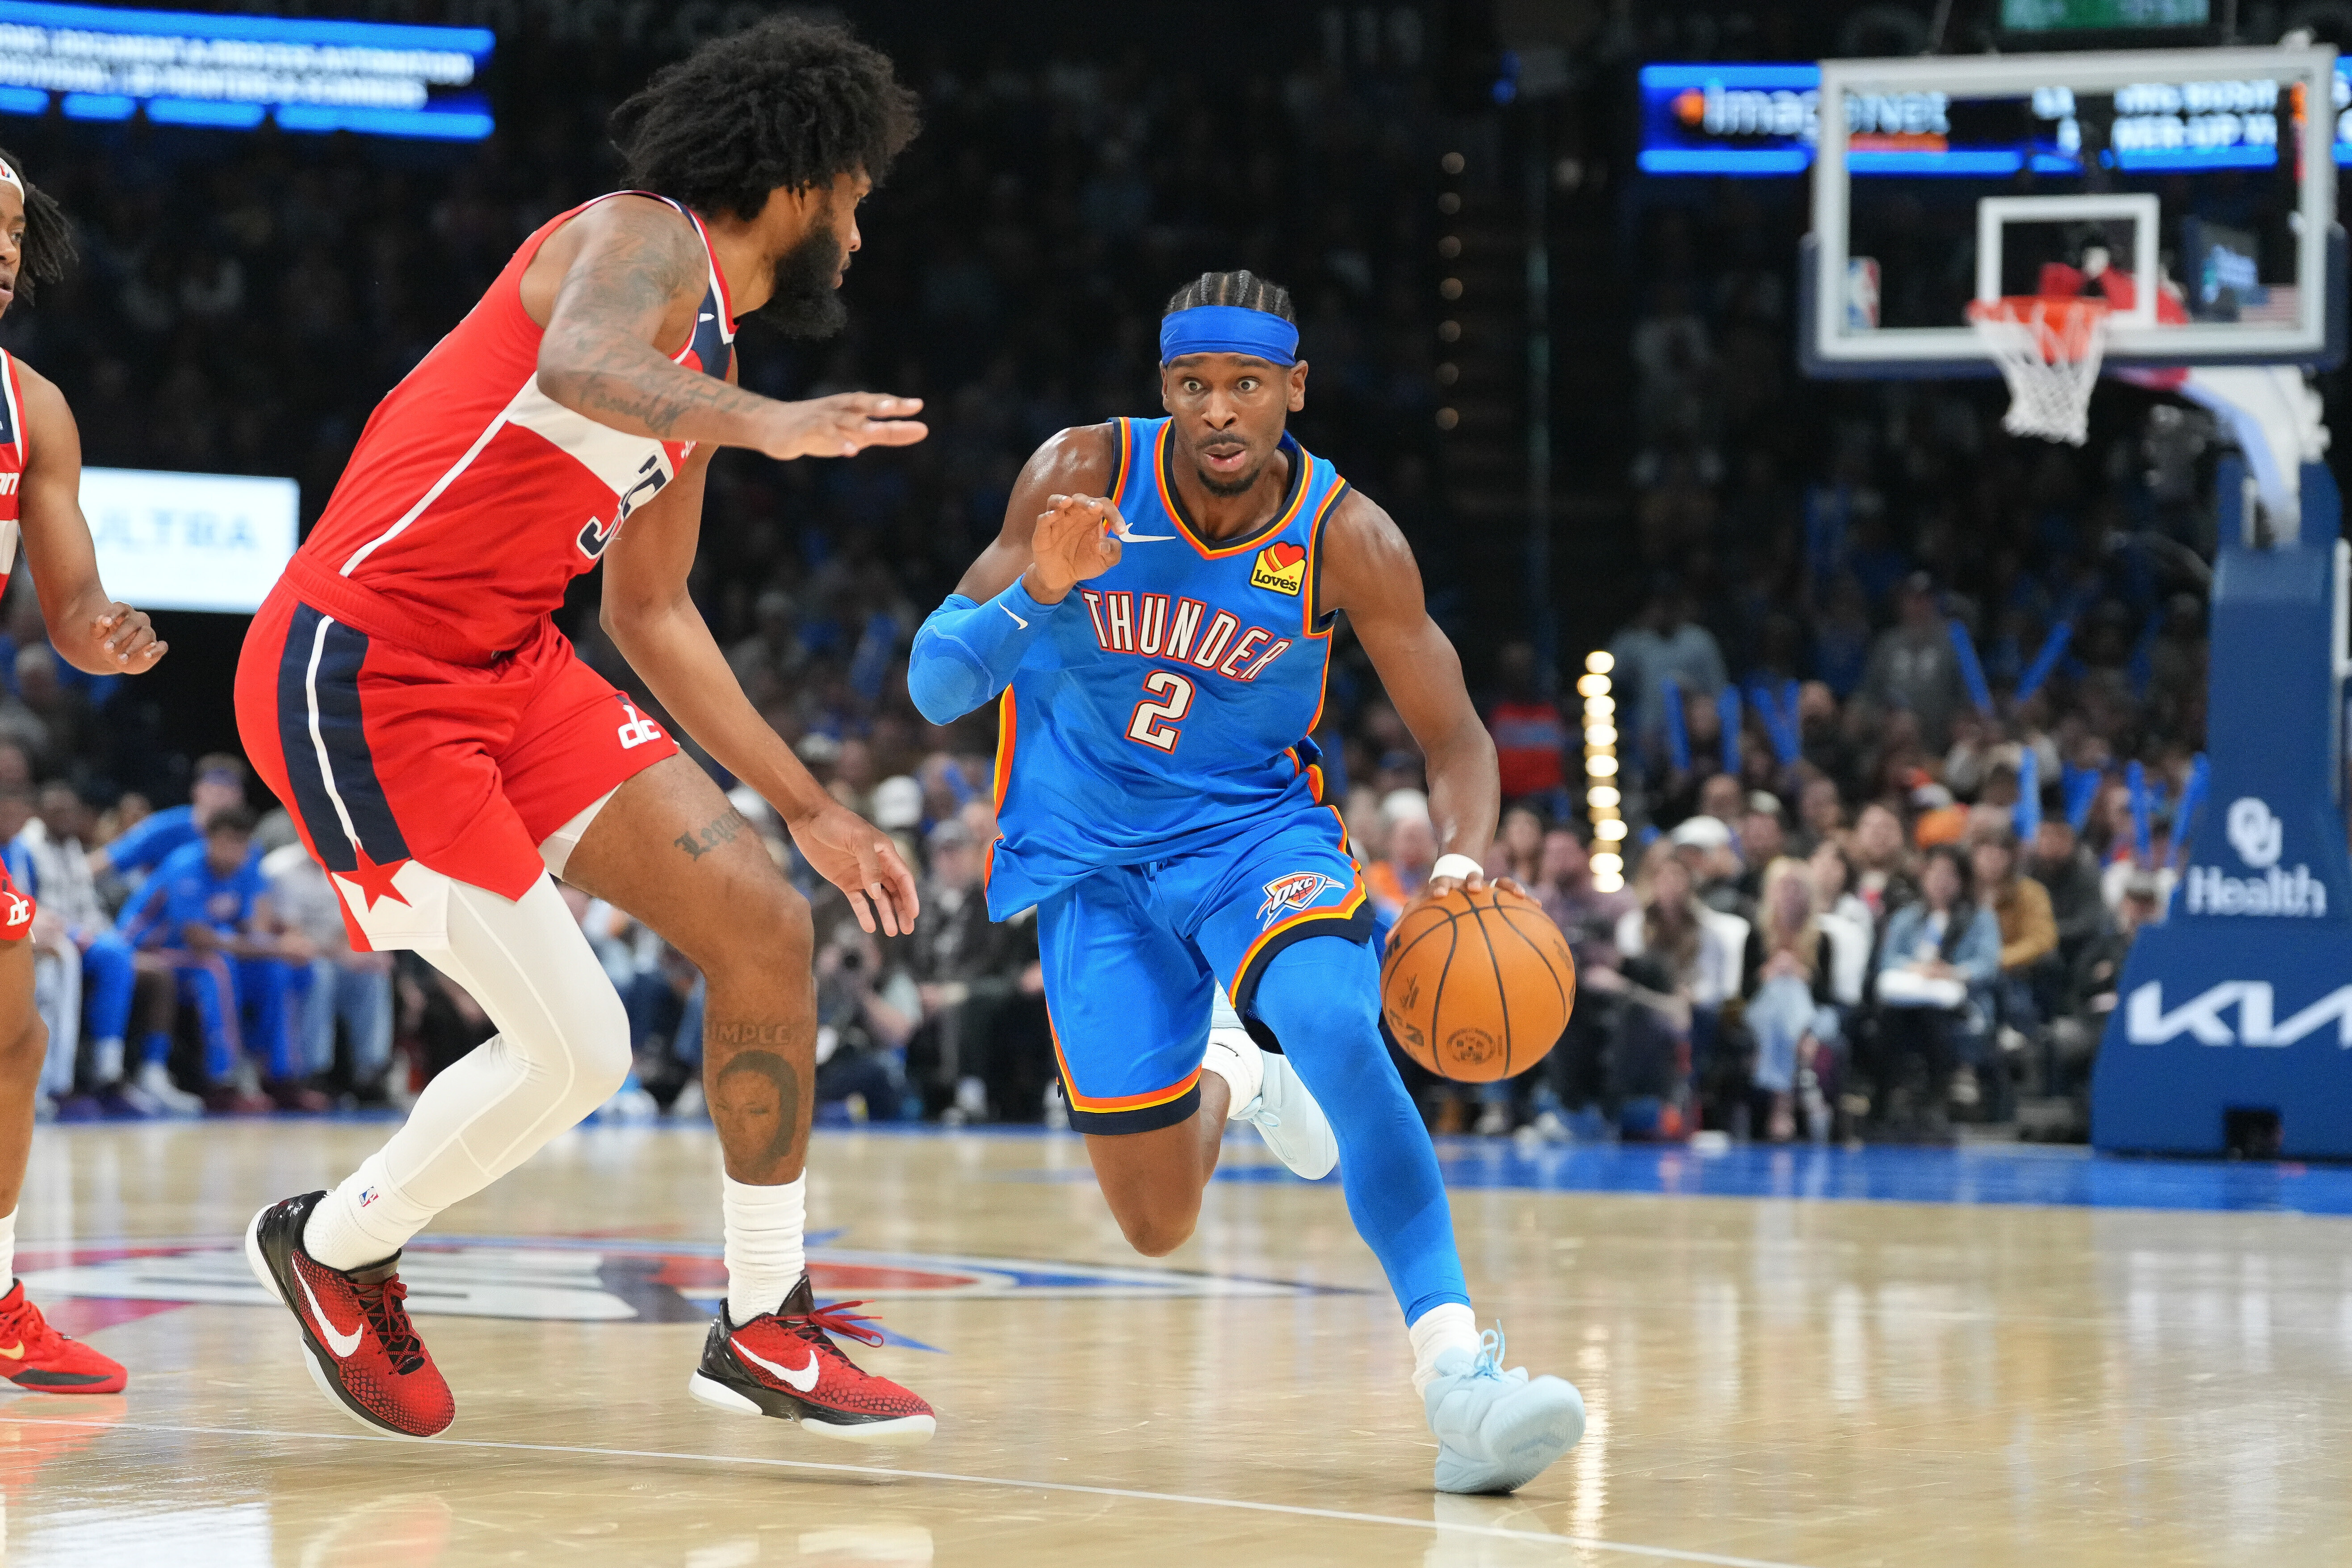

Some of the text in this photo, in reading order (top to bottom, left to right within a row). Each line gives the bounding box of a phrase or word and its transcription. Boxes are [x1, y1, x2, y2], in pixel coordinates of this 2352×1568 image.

[1080, 589, 1292, 682] THUNDER
[1125, 670, 1196, 755] 2
[1270, 876, 1314, 913] OKC
[2187, 864, 2326, 917] Health
